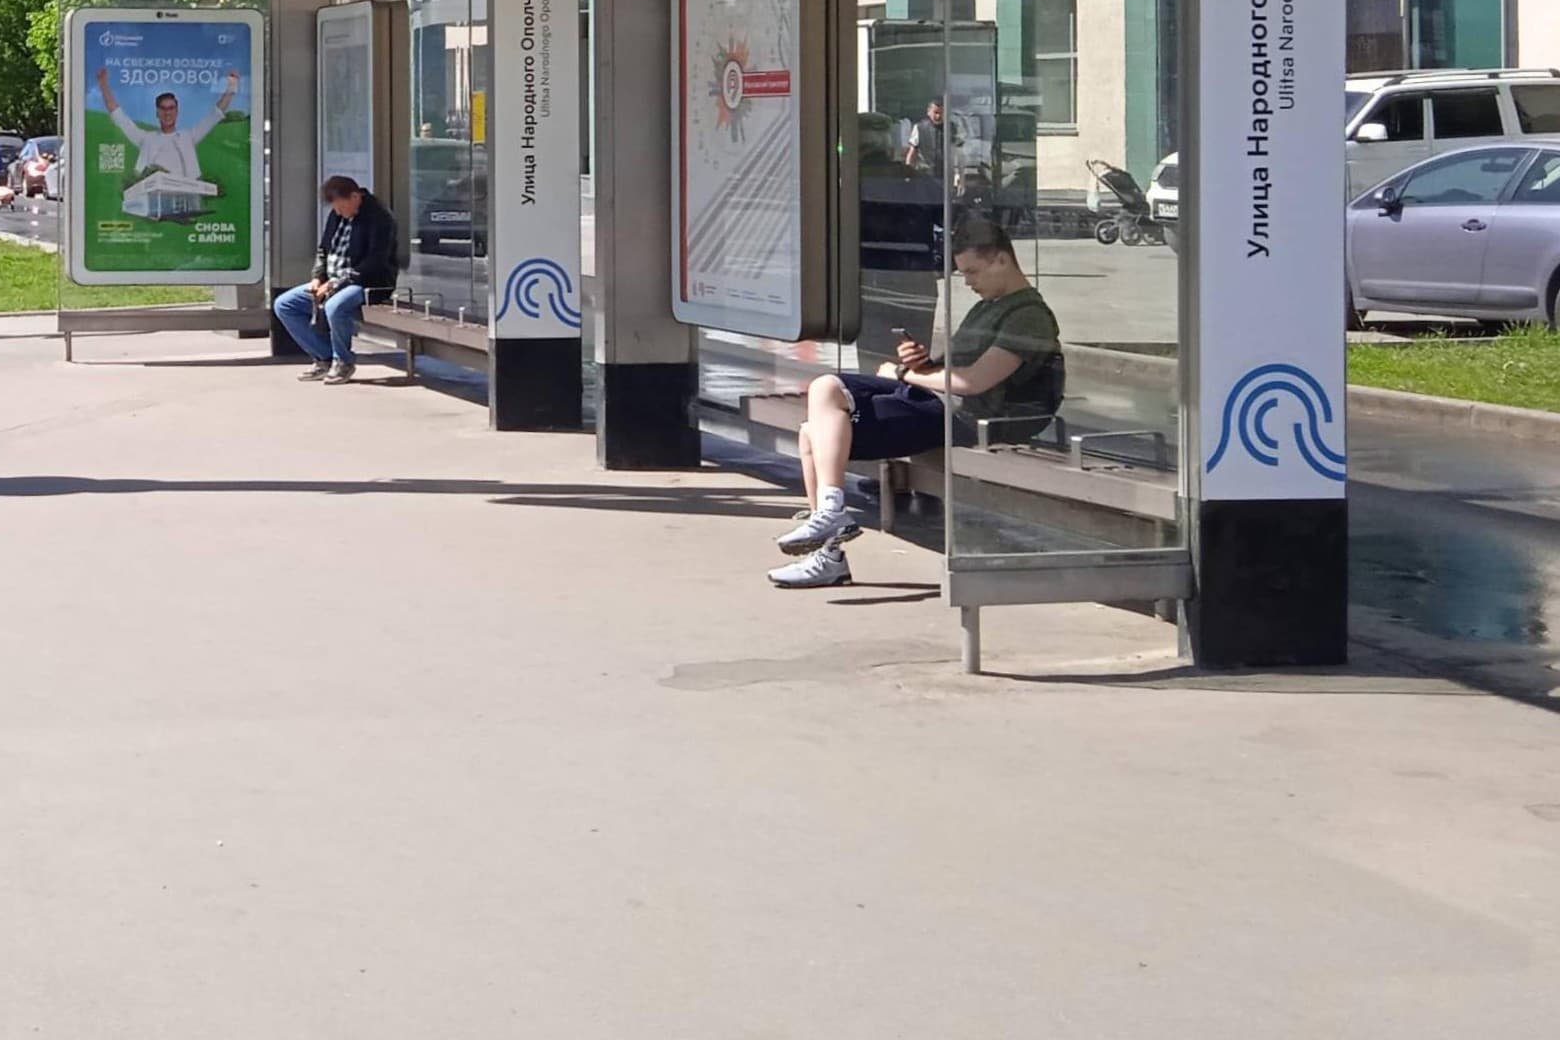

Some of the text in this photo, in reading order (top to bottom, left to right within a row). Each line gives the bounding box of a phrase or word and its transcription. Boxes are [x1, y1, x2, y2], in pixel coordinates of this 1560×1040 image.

[105, 58, 121, 67] НА
[122, 58, 172, 67] СВЕЖЕМ
[120, 69, 218, 85] ЗДОРОВО!
[541, 25, 551, 86] Narodnogo
[521, 56, 538, 149] Народного
[541, 90, 551, 118] Ulitsa
[1279, 57, 1295, 110] Ulitsa
[522, 155, 537, 205] Улица
[195, 223, 236, 232] СНОВА
[1248, 167, 1271, 258] Улица
